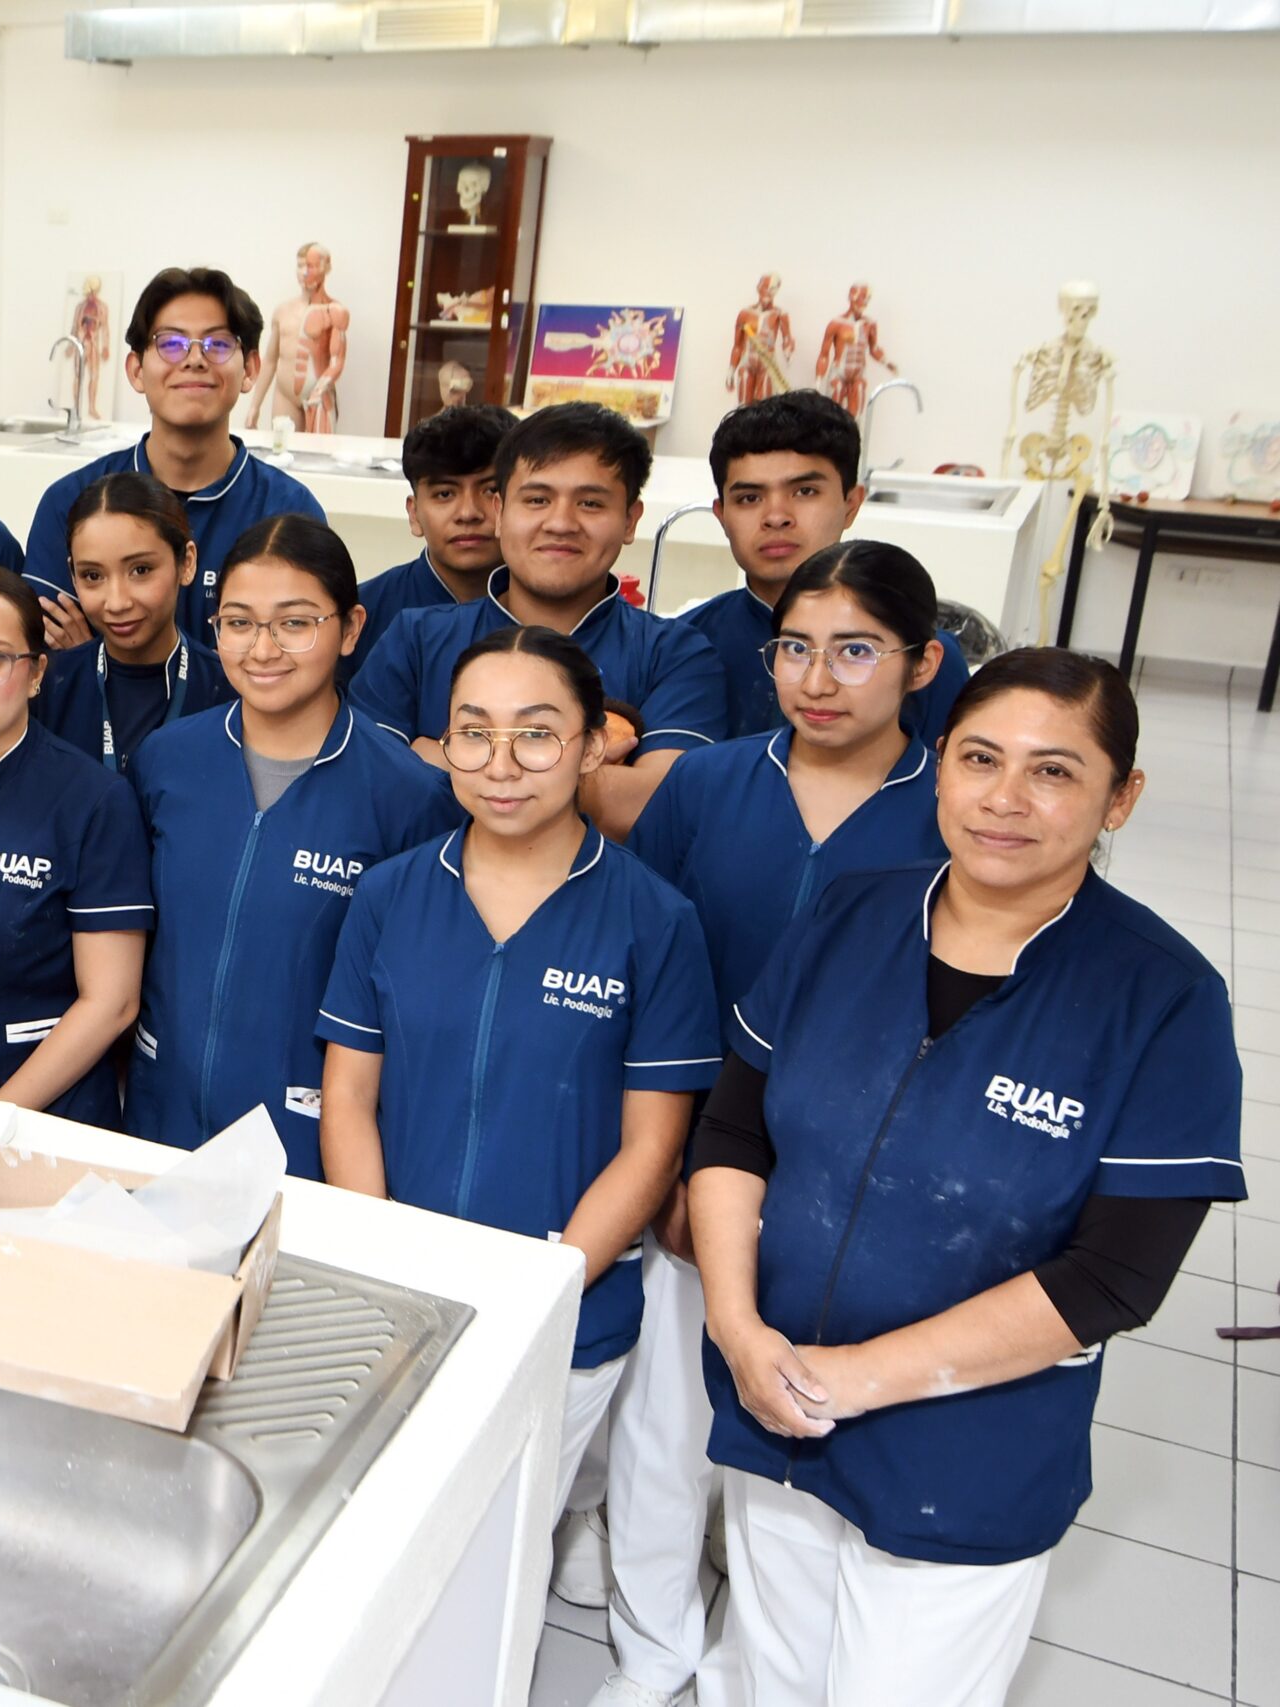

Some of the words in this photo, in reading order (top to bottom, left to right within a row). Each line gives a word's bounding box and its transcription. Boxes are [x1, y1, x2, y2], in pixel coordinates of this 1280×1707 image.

[178, 646, 189, 680] BUAP
[103, 720, 114, 755] BUAP
[293, 849, 364, 880] BUAP
[293, 872, 308, 886] Lic.
[542, 967, 625, 1000] BUAP
[543, 992, 560, 1007] Lic.
[984, 1074, 1086, 1123] BUAP
